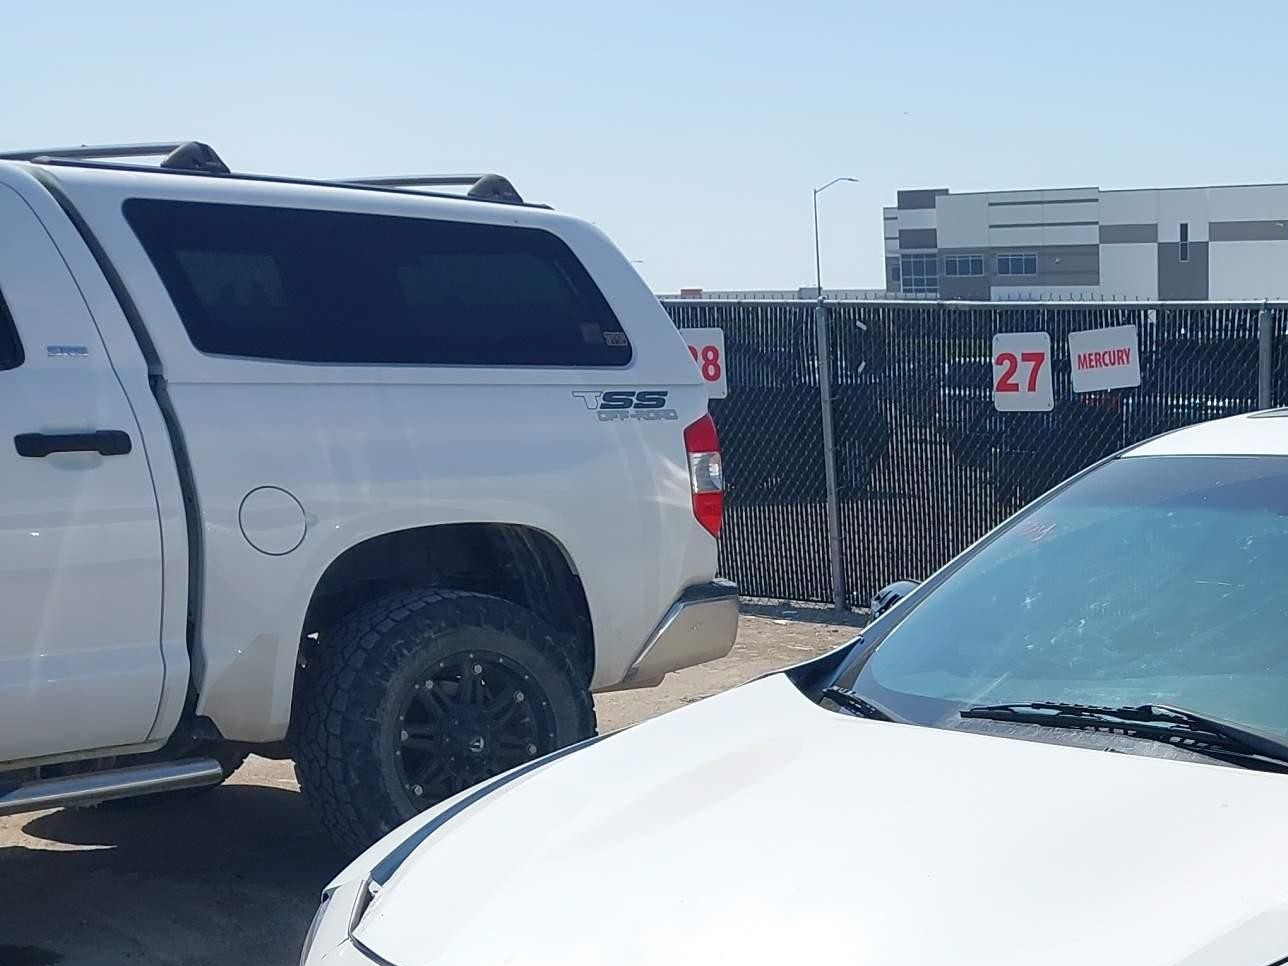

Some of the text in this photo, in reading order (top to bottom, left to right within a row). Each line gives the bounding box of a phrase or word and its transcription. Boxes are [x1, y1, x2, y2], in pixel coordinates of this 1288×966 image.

[687, 345, 721, 382] 8
[995, 352, 1045, 393] 27
[1077, 348, 1132, 370] MERCURY
